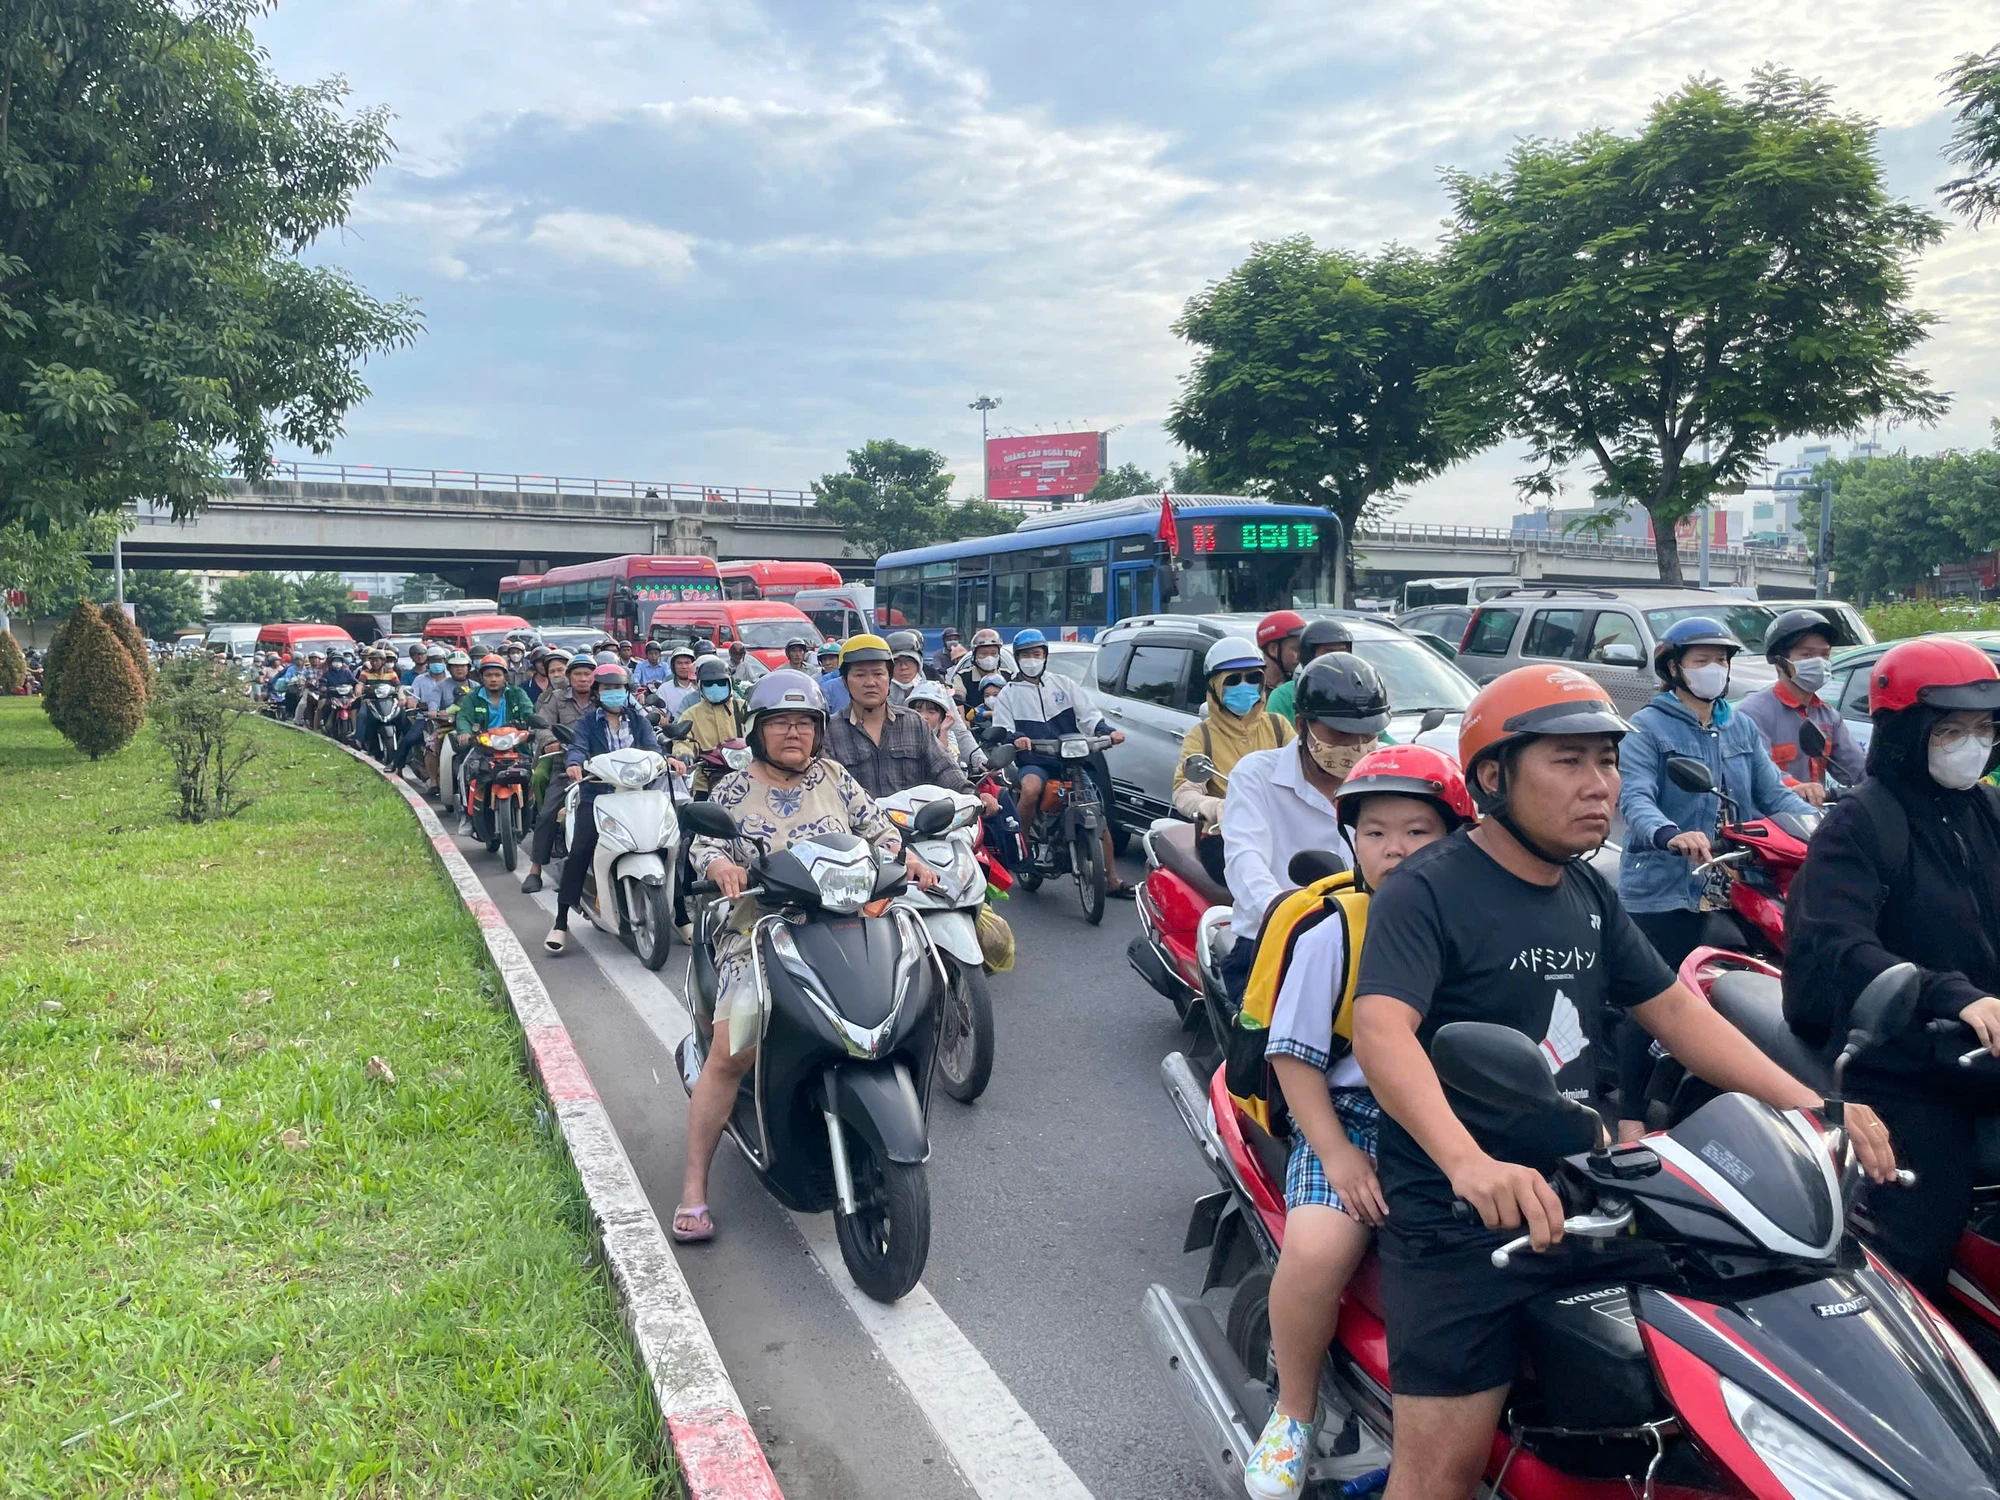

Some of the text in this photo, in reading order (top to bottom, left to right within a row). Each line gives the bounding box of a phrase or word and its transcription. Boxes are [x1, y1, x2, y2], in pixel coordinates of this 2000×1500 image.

[1509, 946, 1596, 973] バドミントン
